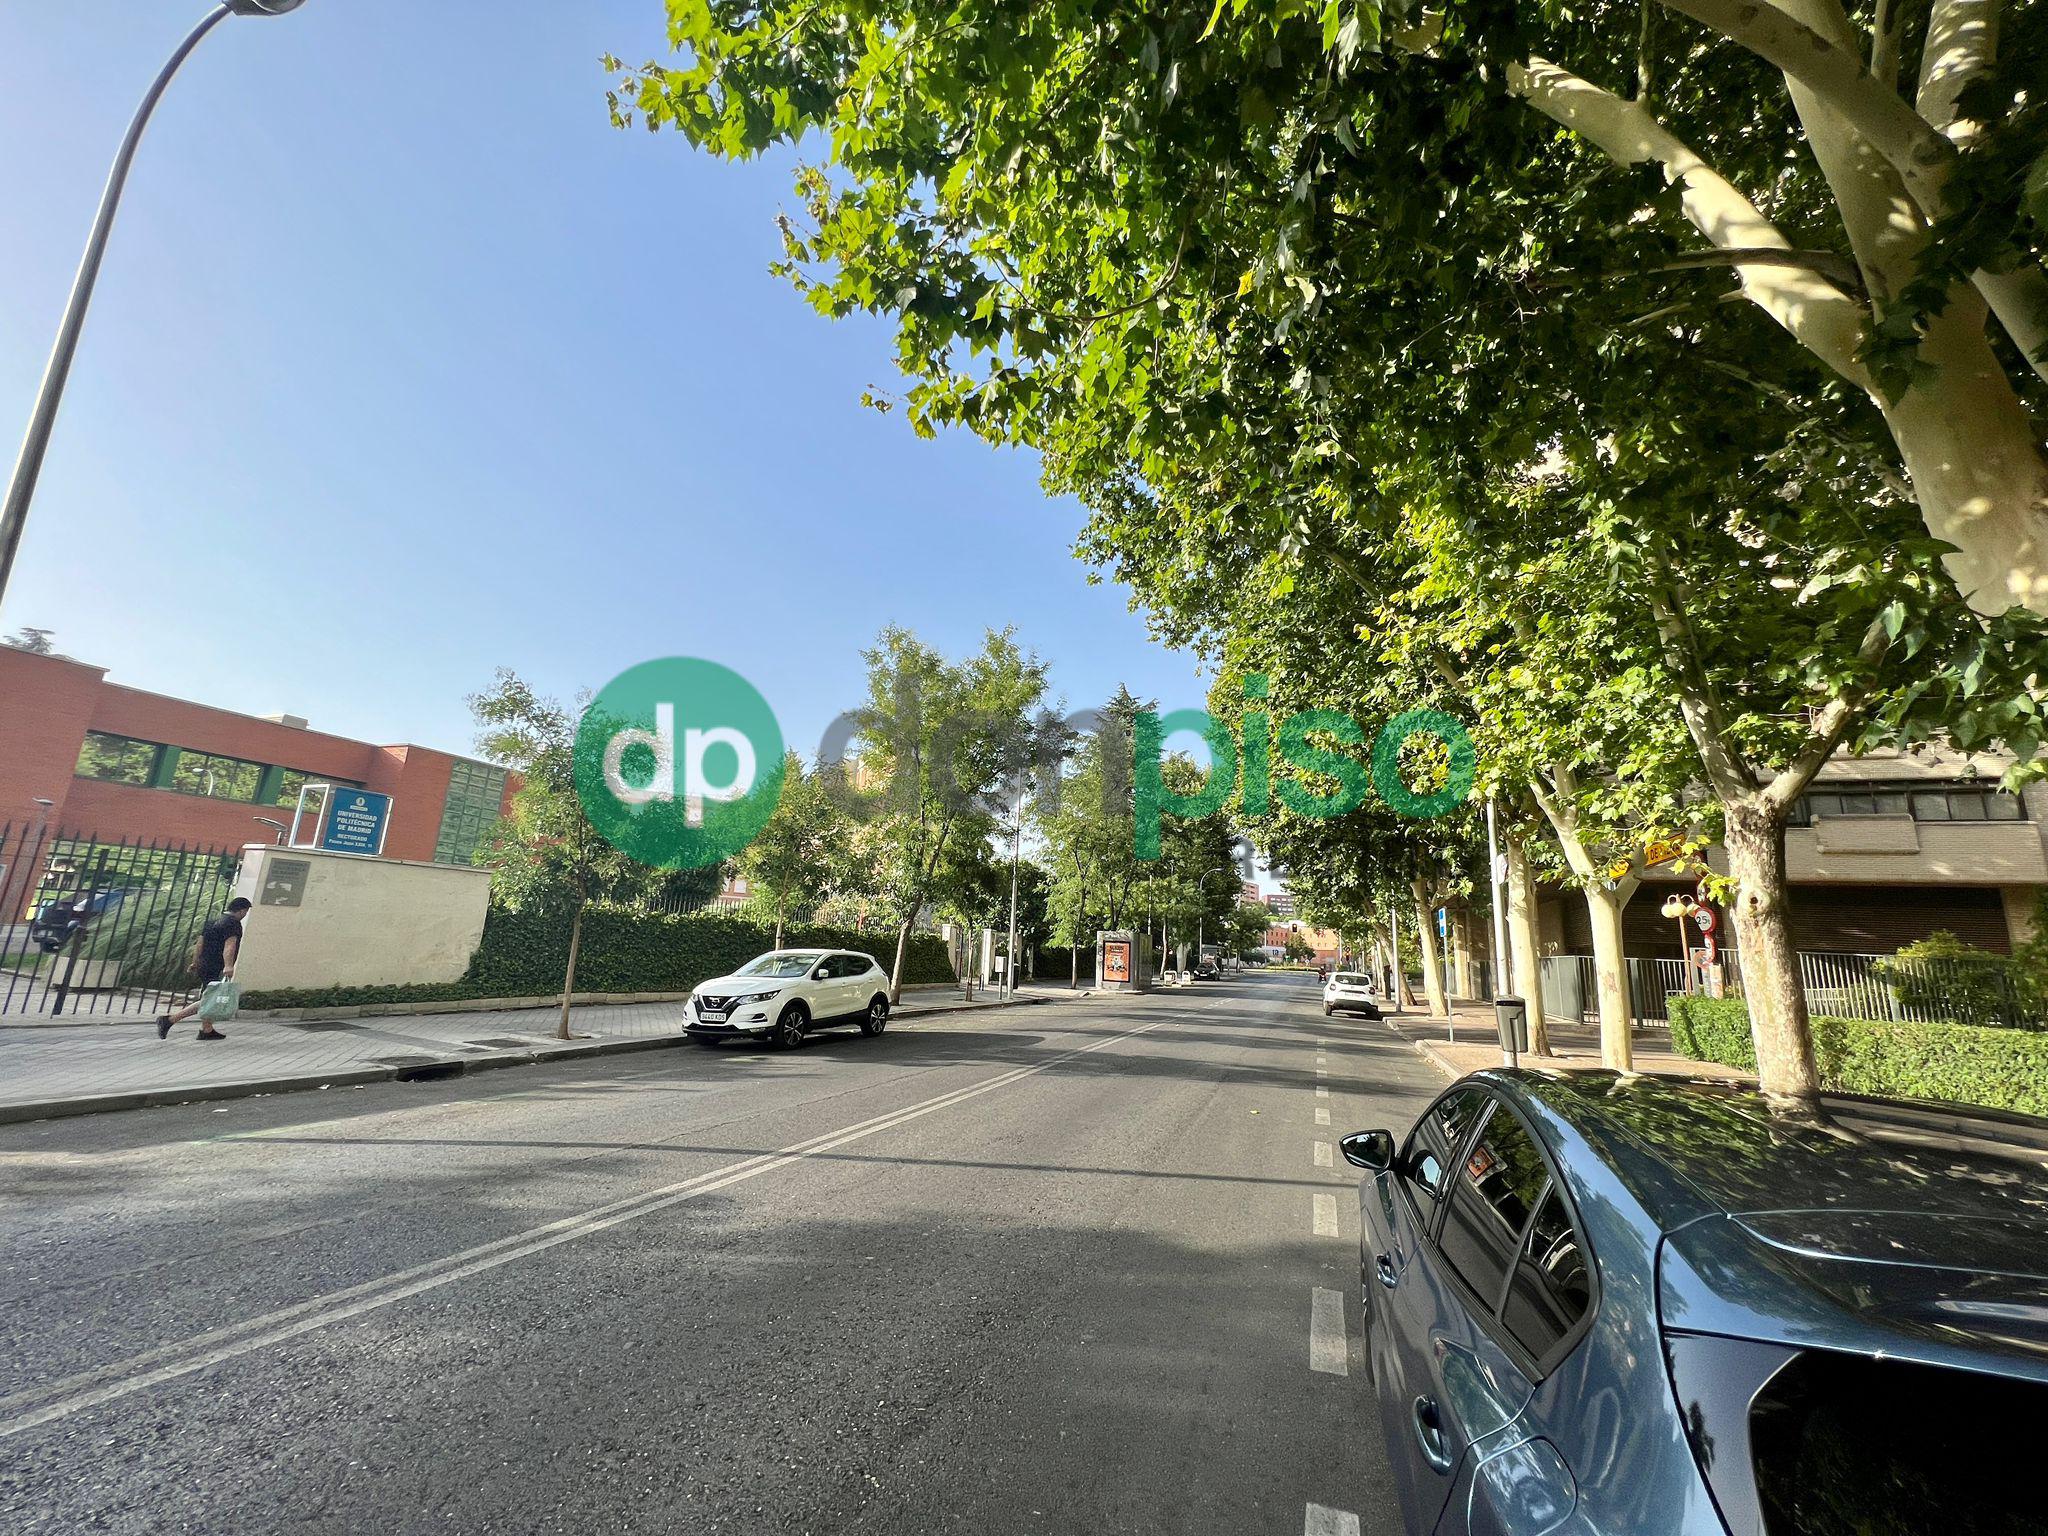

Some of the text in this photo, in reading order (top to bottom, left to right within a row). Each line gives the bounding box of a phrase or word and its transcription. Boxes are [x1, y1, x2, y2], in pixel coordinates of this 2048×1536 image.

[337, 810, 378, 822] UNIVERSIDAD
[336, 817, 375, 828] POLITÉCNICA
[347, 825, 372, 834] MADRID
